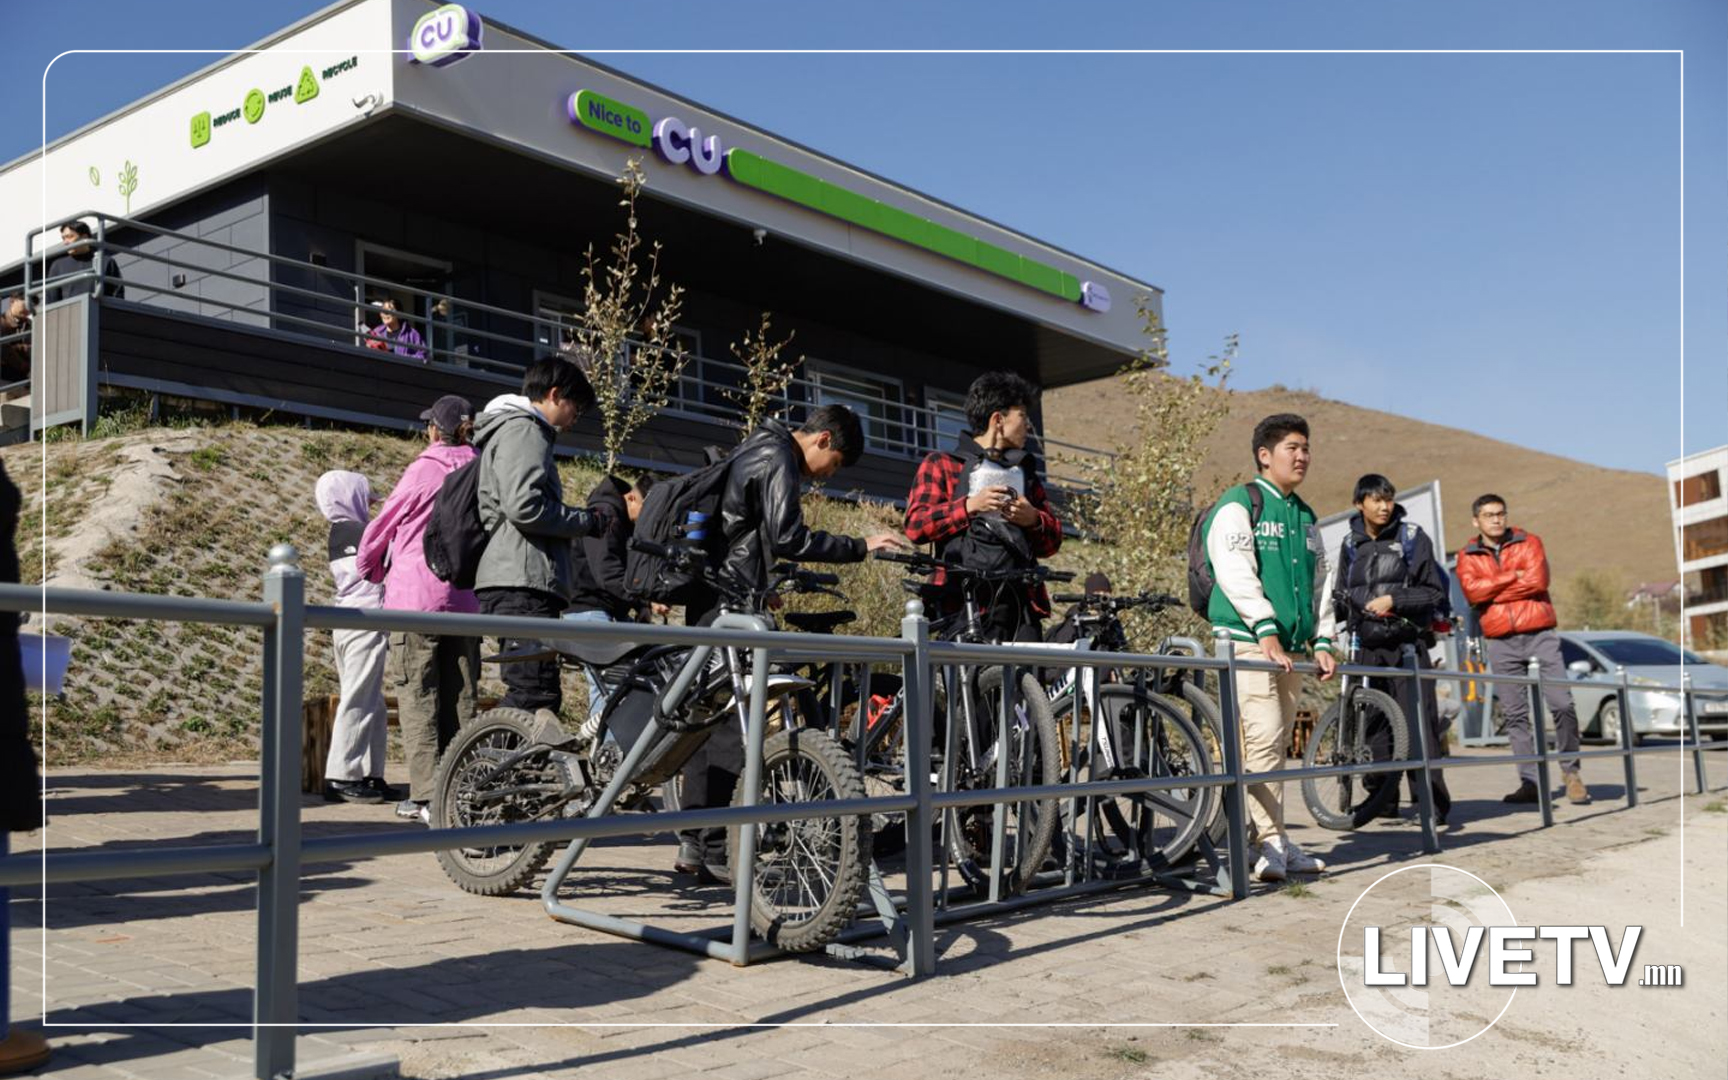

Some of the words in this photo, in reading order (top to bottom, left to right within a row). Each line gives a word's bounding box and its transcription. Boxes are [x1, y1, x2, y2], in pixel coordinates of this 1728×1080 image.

[421, 17, 451, 49] CU
[213, 108, 241, 127] REDUCE
[268, 85, 292, 103] REUSE
[322, 56, 358, 80] RECYCLE
[588, 100, 623, 127] Nice
[626, 116, 641, 134] to
[653, 116, 722, 175] CU
